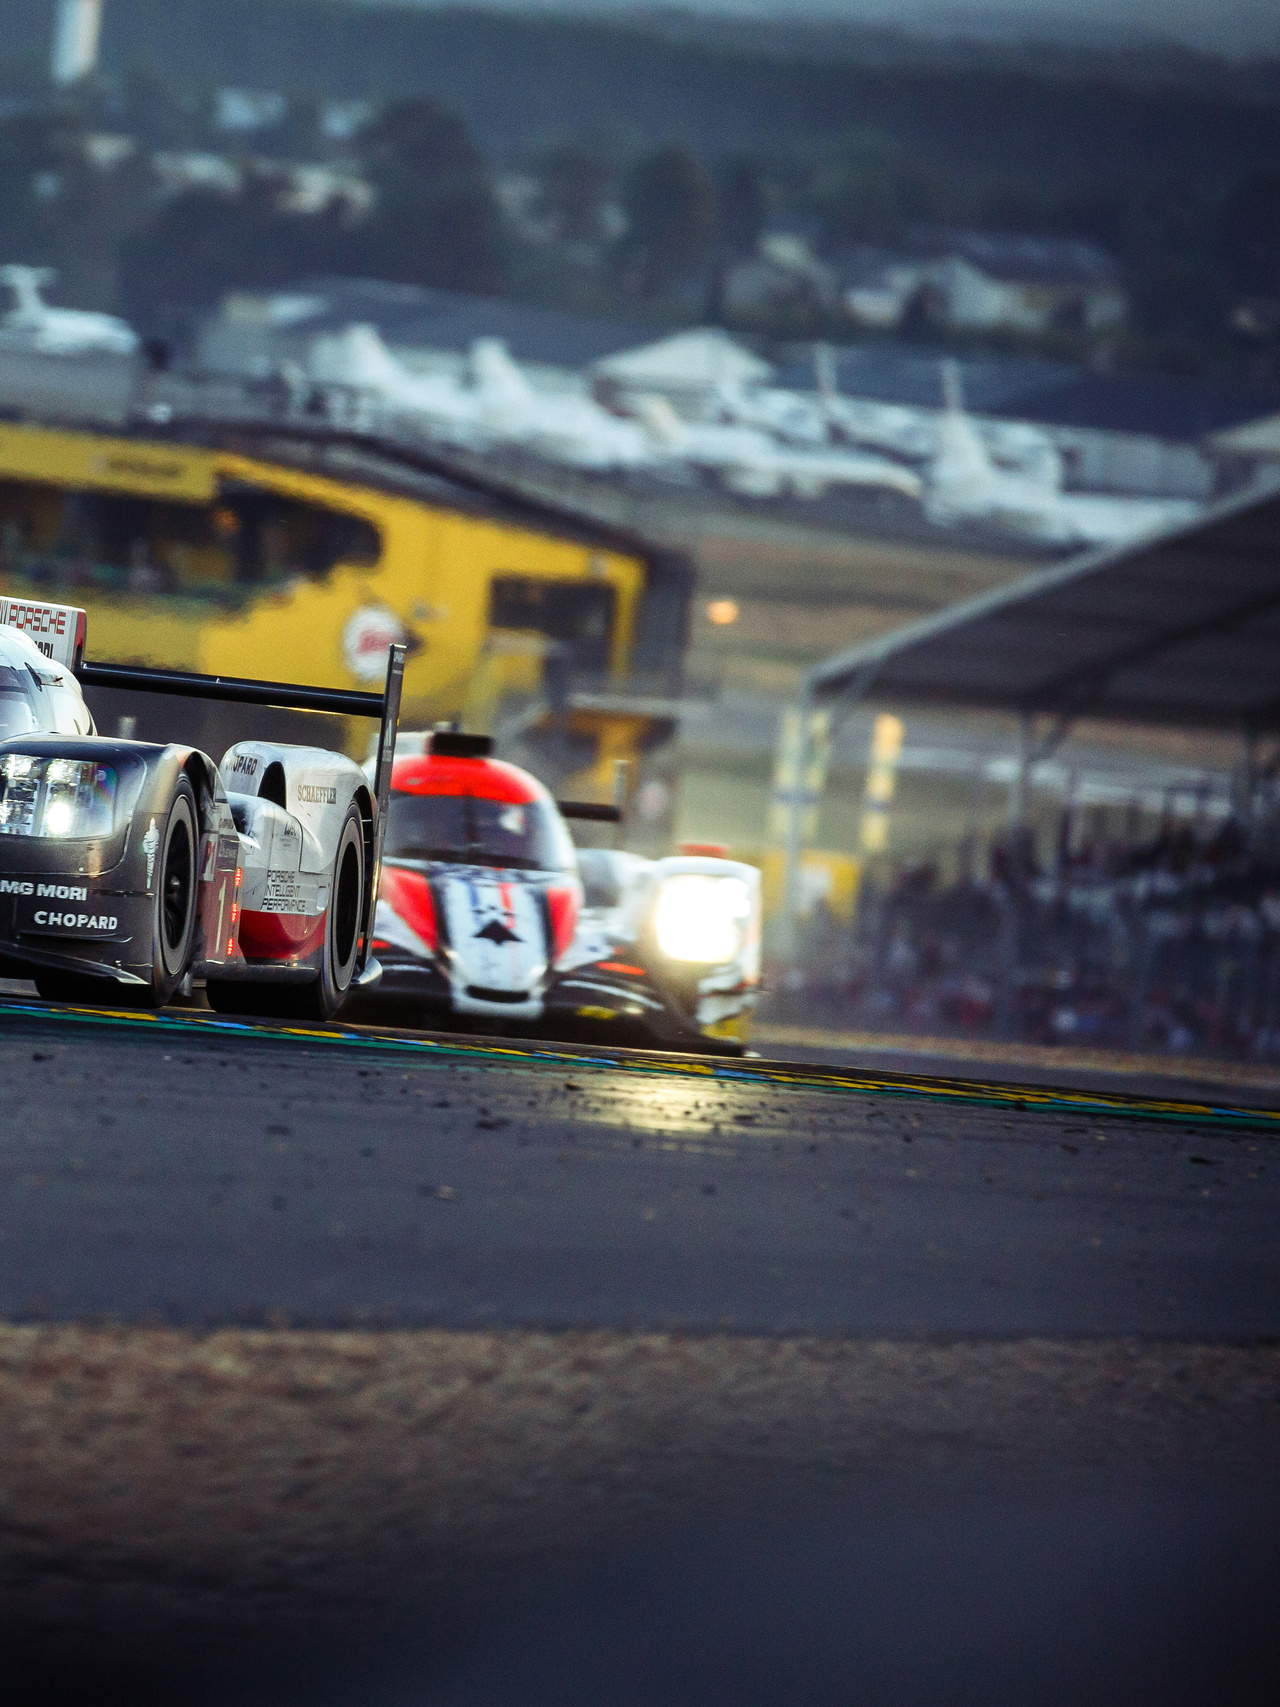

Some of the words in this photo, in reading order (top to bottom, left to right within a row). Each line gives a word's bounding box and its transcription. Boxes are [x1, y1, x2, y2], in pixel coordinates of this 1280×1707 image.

[8, 604, 66, 635] PORSCHE
[225, 755, 258, 776] OPARD
[297, 784, 337, 804] SCHAEFFLER
[266, 869, 295, 884] PORSCHE
[36, 884, 88, 901] MORI
[265, 884, 301, 898] INTELLIGENT
[260, 897, 307, 913] PERFORMANCE
[33, 910, 118, 930] CHOPARD
